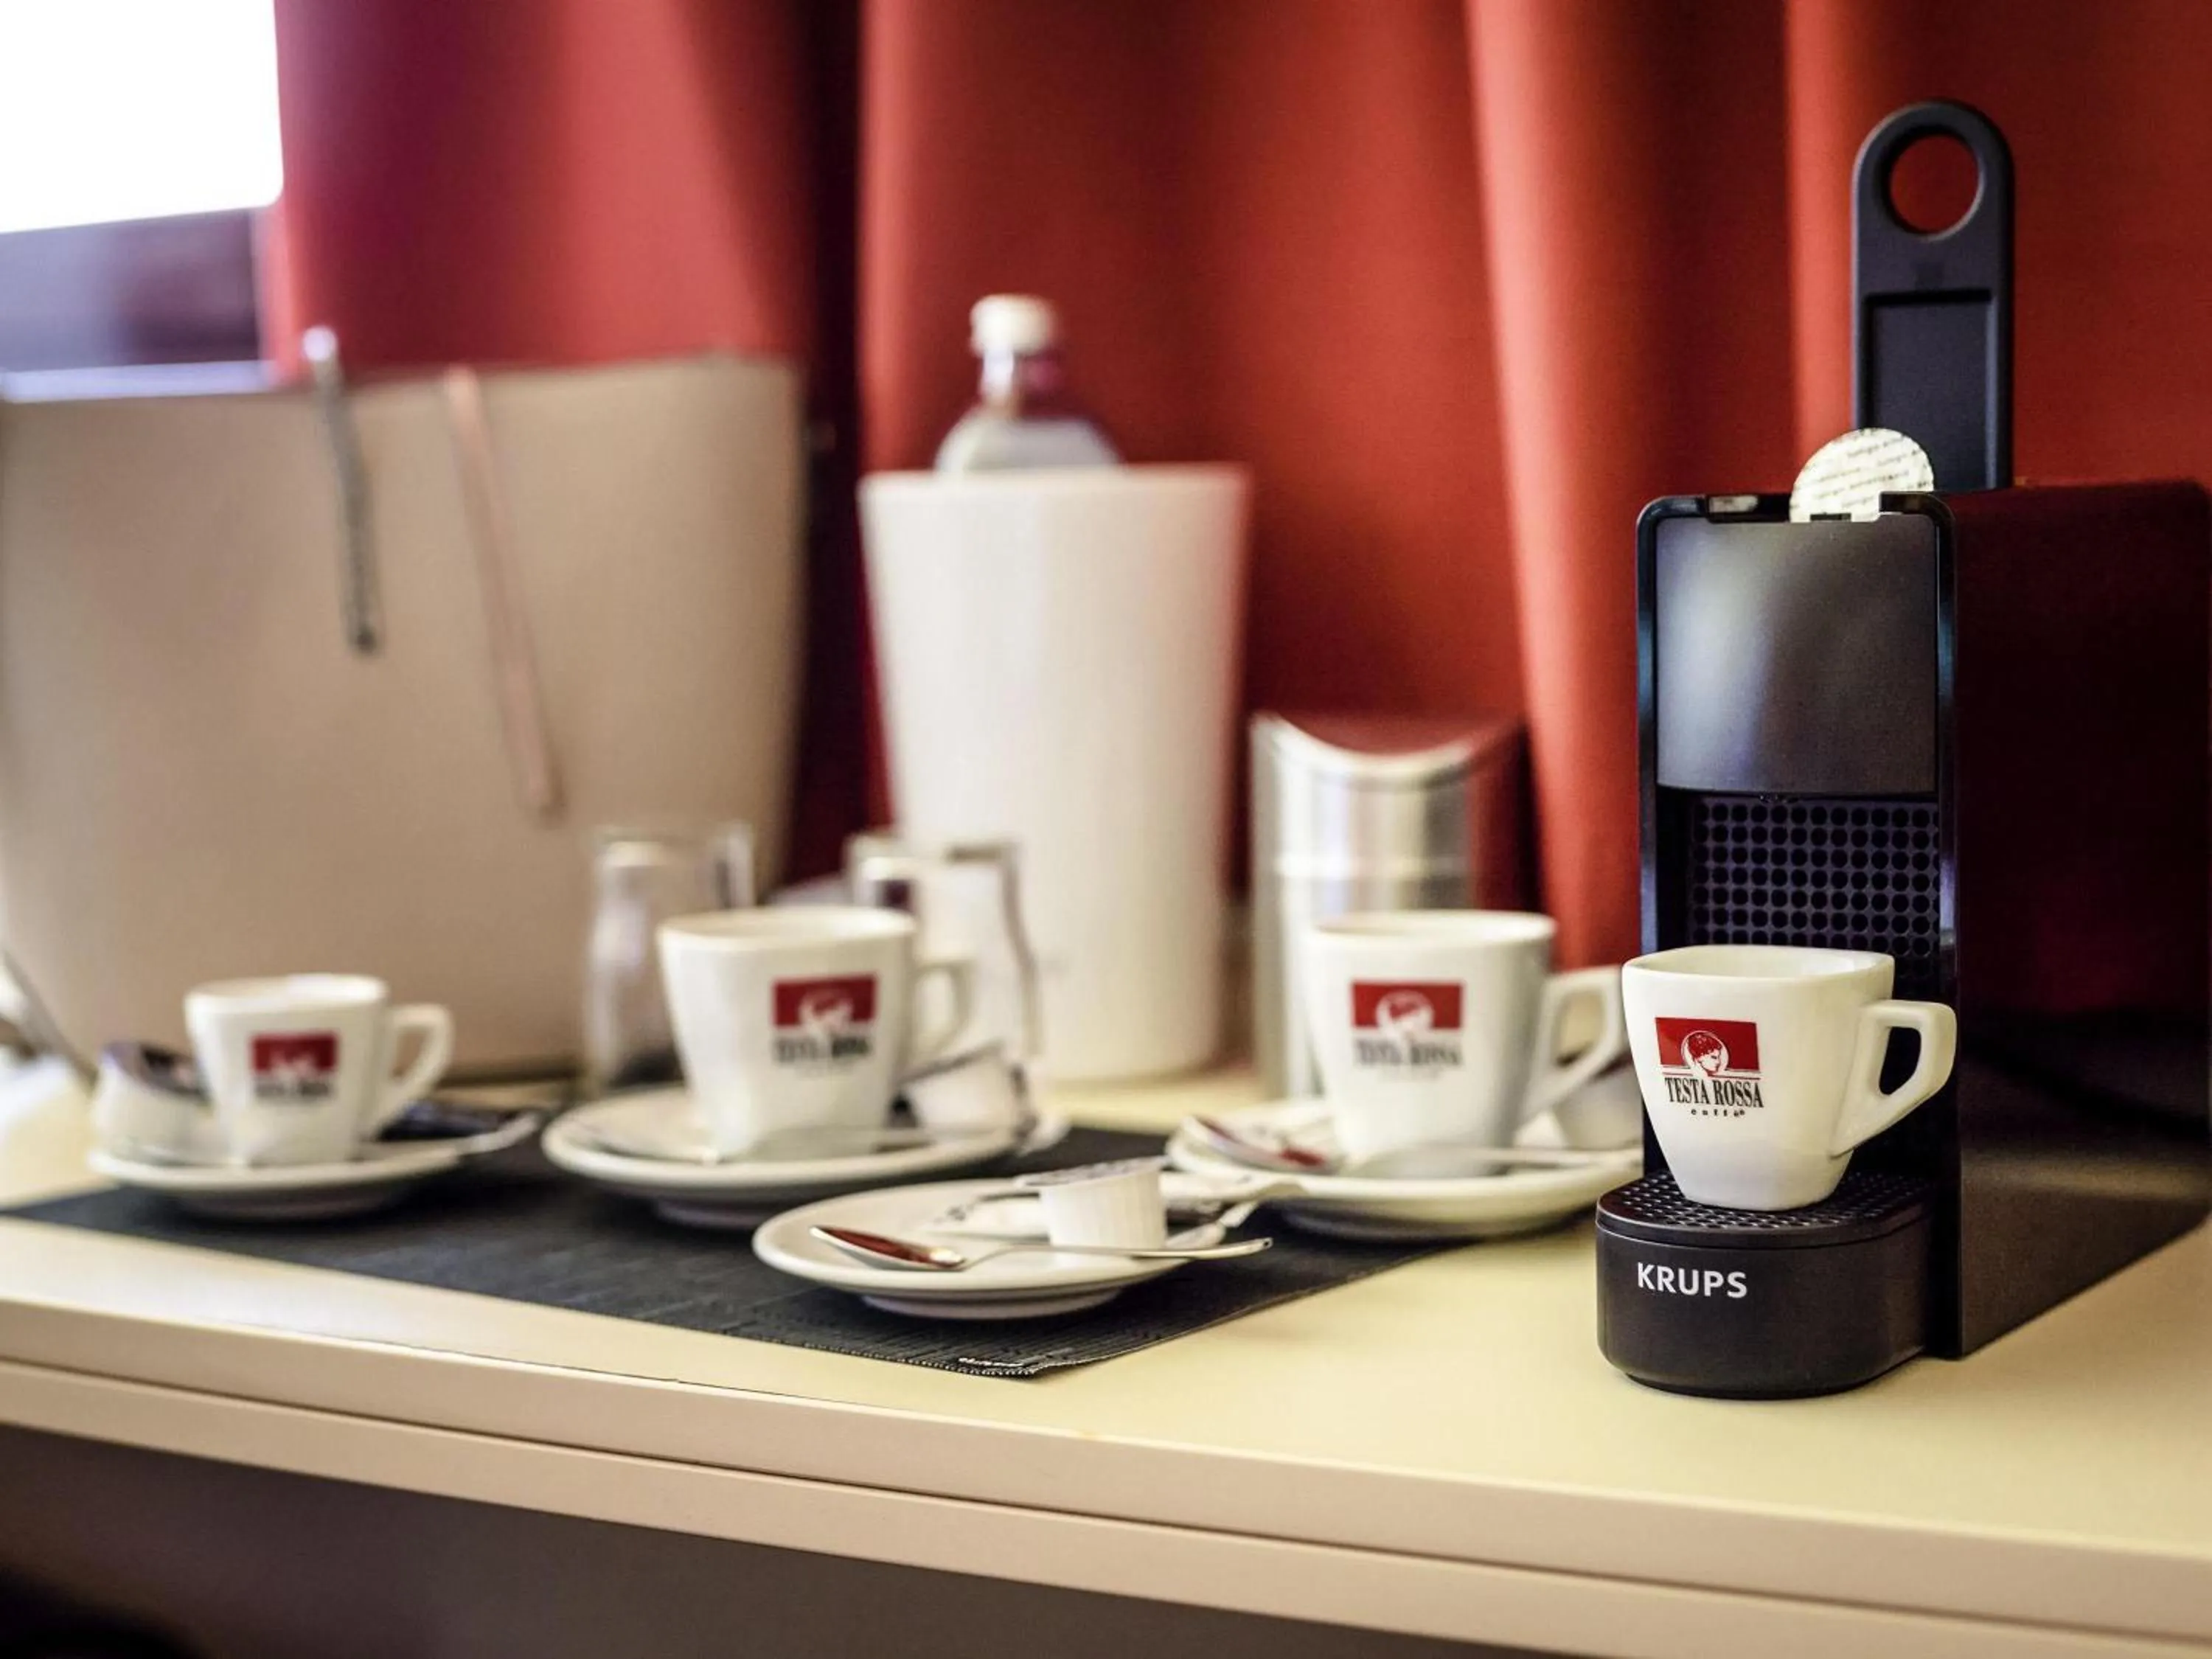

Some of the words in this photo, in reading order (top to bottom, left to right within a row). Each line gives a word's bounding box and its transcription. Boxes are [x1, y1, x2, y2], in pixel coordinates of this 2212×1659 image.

[1665, 1077, 1711, 1105] TESTA
[1712, 1079, 1764, 1107] ROSSA
[1638, 1262, 1747, 1298] KRUPS
